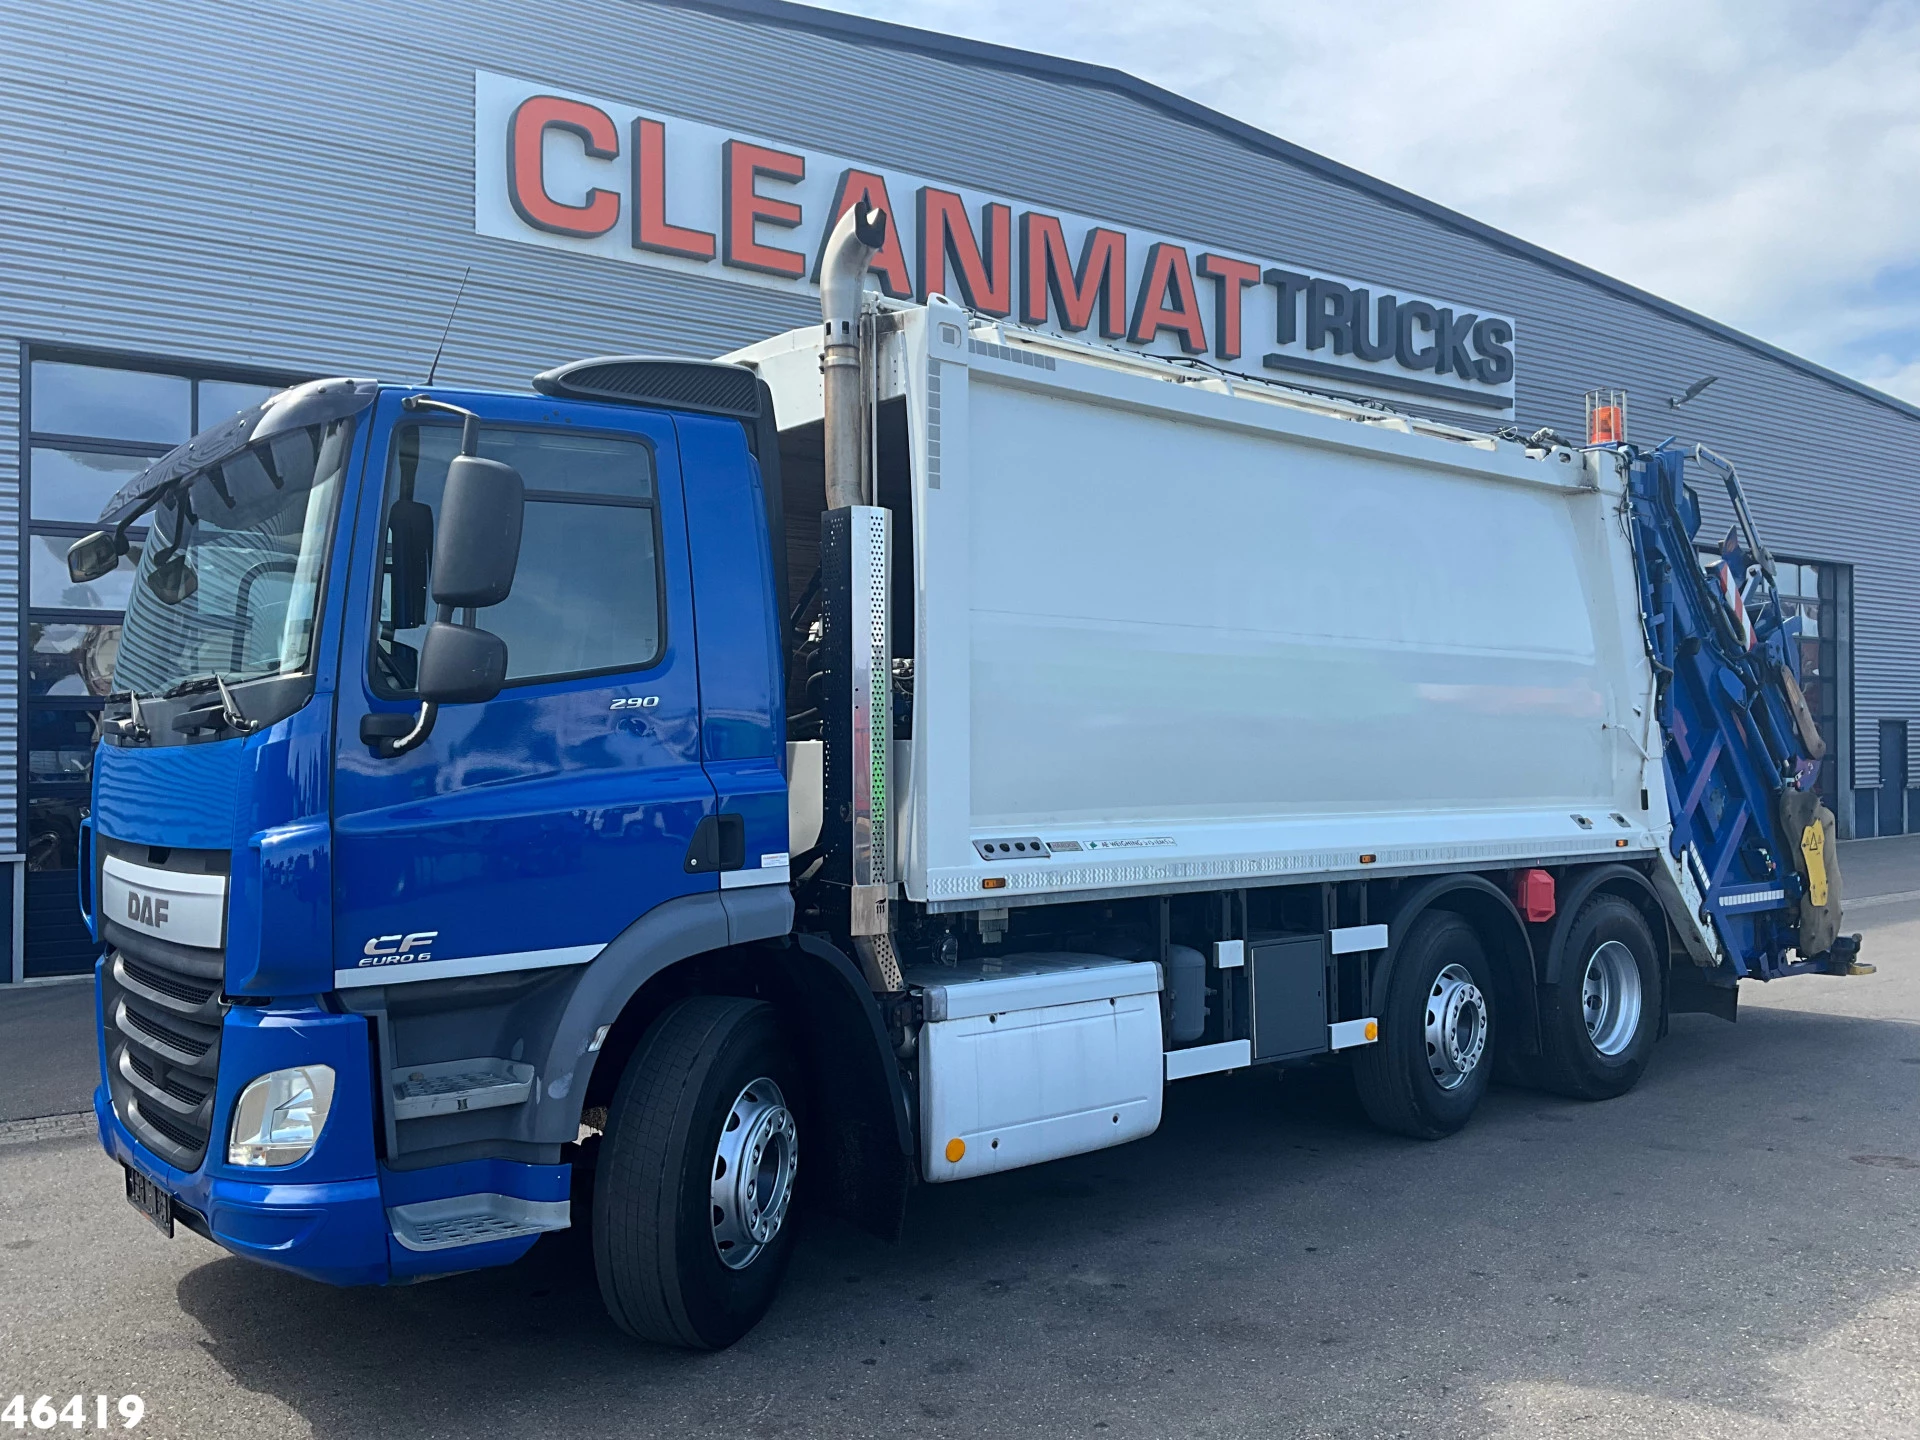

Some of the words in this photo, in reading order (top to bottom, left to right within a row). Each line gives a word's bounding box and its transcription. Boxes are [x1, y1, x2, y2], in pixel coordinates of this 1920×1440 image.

[506, 94, 1261, 361] CLEANMAT
[1264, 267, 1514, 386] TRUCKS
[609, 696, 659, 710] 290
[128, 891, 169, 928] DAF
[364, 931, 439, 955] CF
[358, 954, 414, 967] EURO
[417, 952, 431, 961] 6
